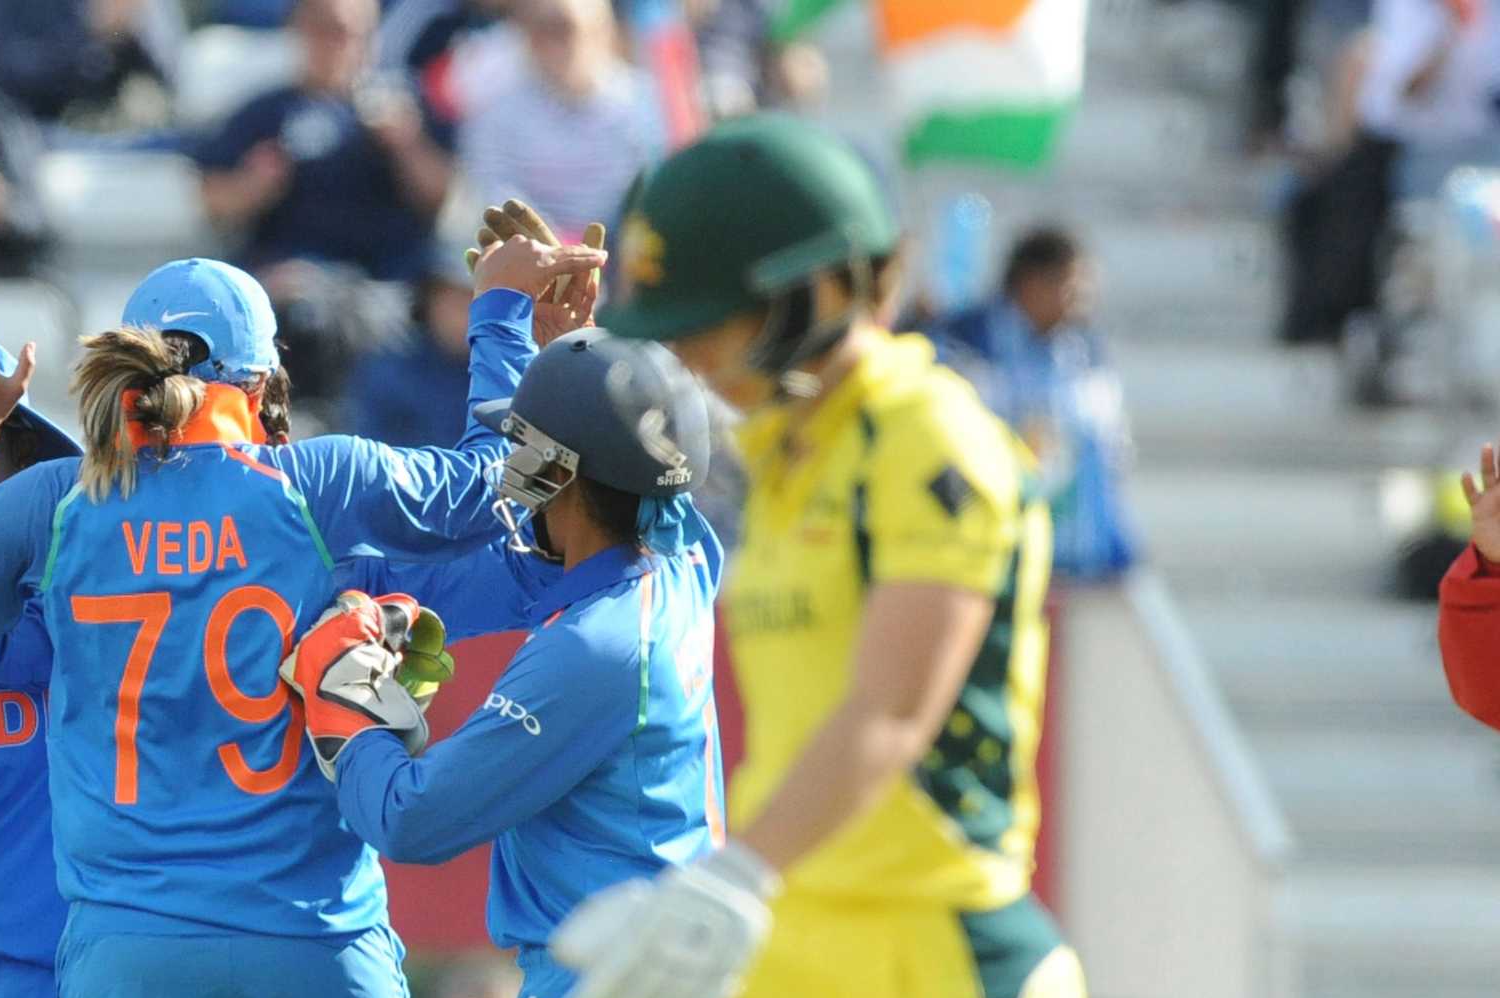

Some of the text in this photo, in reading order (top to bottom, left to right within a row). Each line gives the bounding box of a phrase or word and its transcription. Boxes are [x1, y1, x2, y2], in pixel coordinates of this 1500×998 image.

[122, 515, 248, 576] VEDA
[70, 585, 306, 804] 79
[484, 692, 541, 736] ppo
